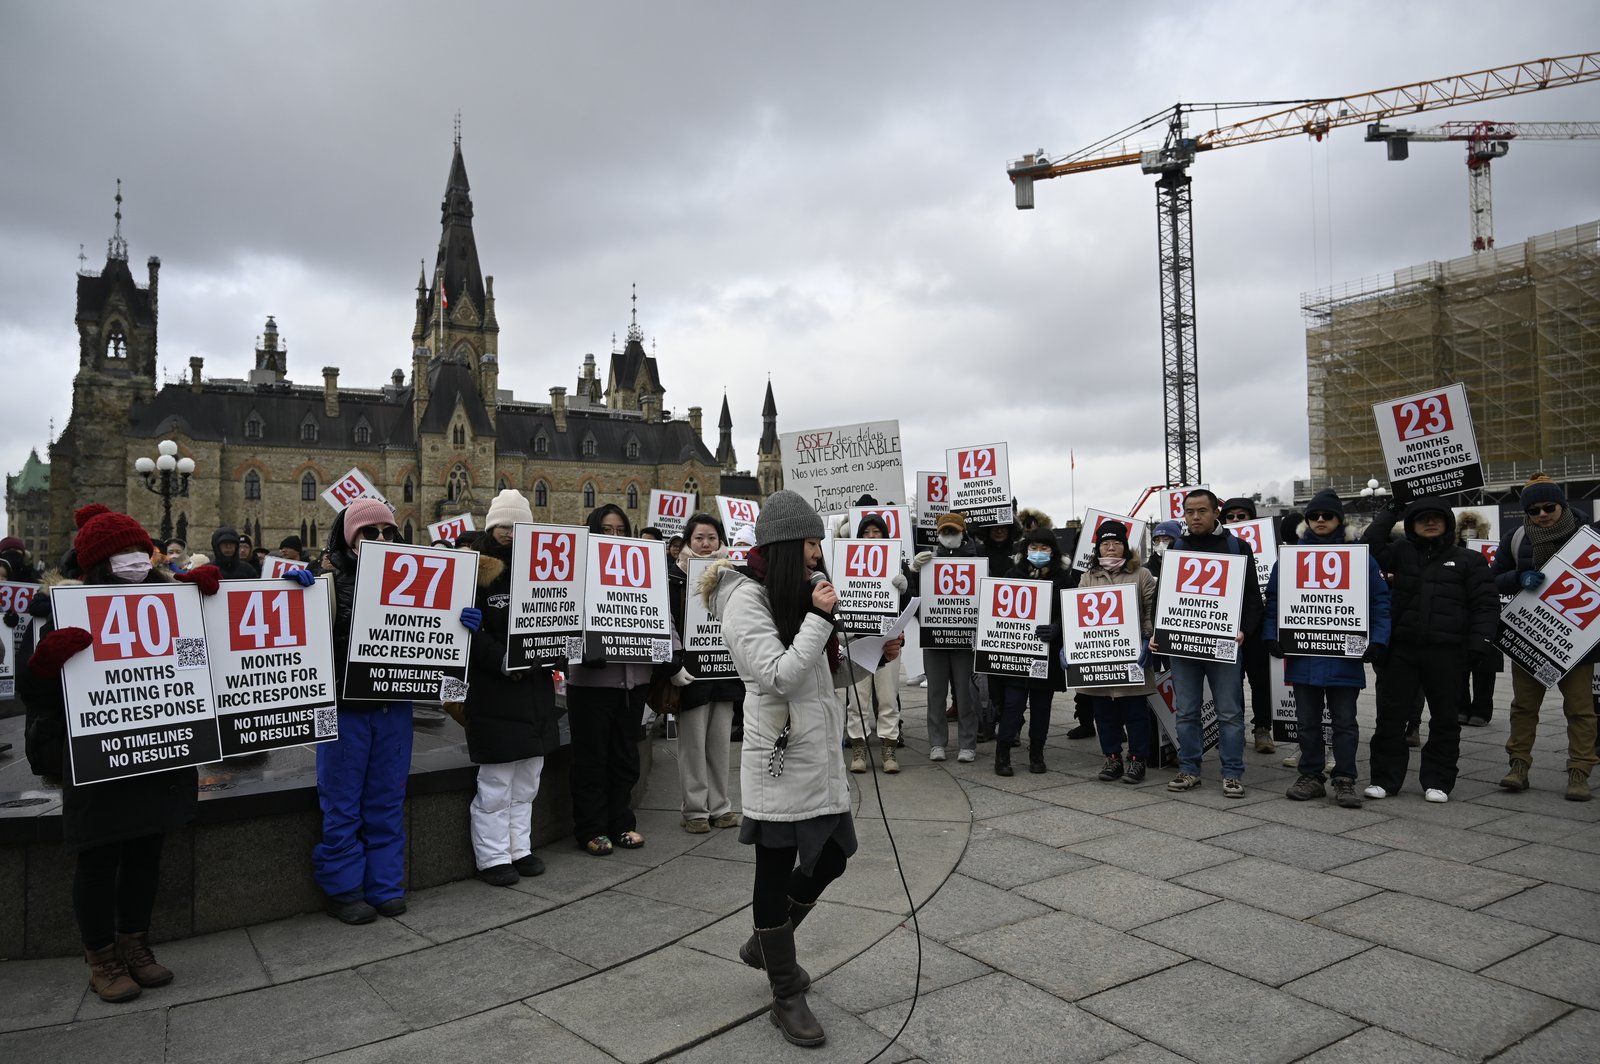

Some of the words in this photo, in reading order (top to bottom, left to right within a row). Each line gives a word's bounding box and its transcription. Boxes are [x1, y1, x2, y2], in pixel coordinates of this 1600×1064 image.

[1400, 398, 1446, 439] 23
[796, 432, 833, 450] ASSEZ
[836, 431, 852, 446] des
[857, 427, 883, 441] délais
[1406, 436, 1449, 453] MONTHS
[798, 437, 901, 464] INTERMINABLE
[1397, 449, 1440, 465] WAITING
[1443, 444, 1463, 455] FOR
[792, 469, 808, 479] Nos
[810, 468, 827, 476] vies
[831, 463, 849, 475] sont
[852, 463, 863, 472] en
[867, 458, 901, 471] suspens.
[963, 449, 992, 477] 42
[1394, 466, 1416, 477] IRCC
[1418, 453, 1472, 472] RESPONSE
[964, 480, 993, 488] MONTHS
[1407, 480, 1419, 488] NO
[1421, 470, 1464, 485] TIMELINES
[336, 479, 360, 503] 19
[814, 482, 877, 497] Transparence.
[957, 489, 986, 497] WAITING
[1413, 488, 1424, 496] NO
[1427, 480, 1462, 493] RESULTS
[663, 496, 683, 516] 70
[815, 498, 842, 512] Délais
[970, 495, 1006, 504] RESPONSE
[731, 502, 752, 521] 29
[441, 522, 462, 544] 27
[535, 534, 570, 580] 53
[850, 545, 883, 576] 40
[605, 545, 645, 586] 40
[1304, 552, 1342, 588] 19
[388, 554, 447, 607] 27
[939, 565, 970, 595] 65
[1181, 559, 1222, 595] 22
[849, 581, 881, 589] MONTHS
[532, 588, 567, 598] MONTHS
[607, 592, 647, 603] MONTHS
[841, 590, 872, 598] WAITING
[874, 591, 889, 599] FOR
[1301, 595, 1343, 603] MONTHS
[522, 602, 557, 613] WAITING
[560, 602, 575, 612] FOR
[998, 586, 1032, 618] 90
[1082, 592, 1119, 625] 32
[1179, 597, 1219, 609] MONTHS
[1545, 577, 1600, 626] 22
[597, 604, 637, 615] WAITING
[640, 606, 658, 616] FOR
[1168, 607, 1207, 618] WAITING
[1210, 612, 1228, 621] FOR
[1290, 605, 1331, 614] WAITING
[1335, 606, 1354, 615] FOR
[101, 595, 170, 657] 40
[239, 591, 297, 647] 41
[385, 614, 441, 628] MONTHS
[516, 617, 535, 628] IRCC
[536, 615, 579, 627] RESPONSE
[591, 616, 612, 626] IRCC
[615, 618, 664, 629] RESPONSE
[996, 621, 1030, 630] MONTHS
[1162, 617, 1181, 626] IRCC
[1183, 620, 1233, 632] RESPONSE
[1285, 616, 1305, 624] IRCC
[1308, 617, 1361, 626] RESPONSE
[1534, 605, 1572, 636] MONTHS
[369, 629, 424, 643] WAITING
[429, 632, 454, 644] FOR
[987, 631, 1020, 640] WAITING
[1023, 633, 1039, 641] FOR
[1084, 629, 1119, 639] MONTHS
[1503, 629, 1514, 640] NO
[1518, 607, 1555, 640] WAITING
[1554, 635, 1574, 652] FOR
[523, 638, 534, 647] NO
[602, 636, 613, 644] NO
[690, 637, 710, 646] IRCC
[1075, 640, 1111, 649] WAITING
[1113, 639, 1130, 647] FOR
[1500, 638, 1511, 648] NO
[1505, 612, 1526, 629] IRCC
[1524, 627, 1571, 663] RESPONSE
[358, 644, 388, 657] IRCC
[390, 647, 460, 660] RESPONSE
[606, 647, 617, 655] NO
[620, 647, 652, 656] RESULTS
[981, 640, 999, 648] IRCC
[1000, 641, 1043, 651] RESPONSE
[1184, 644, 1216, 654] RESULTS
[1311, 642, 1346, 650] RESULTS
[241, 652, 301, 670] MONTHS
[525, 650, 535, 659] NO
[537, 649, 566, 657] RESULTS
[1071, 652, 1089, 660] IRCC
[1091, 649, 1136, 658] RESPONSE
[105, 665, 175, 684] MONTHS
[370, 668, 385, 678] NO
[388, 669, 444, 680] TIMELINES
[701, 664, 711, 672] NO
[1002, 664, 1030, 672] RESULTS
[1091, 664, 1128, 672] TIMELINES
[226, 671, 286, 689] WAITING
[291, 668, 317, 682] FOR
[89, 685, 159, 706] WAITING
[165, 682, 195, 698] FOR
[373, 681, 388, 691] NO
[392, 682, 438, 693] RESULTS
[218, 692, 250, 708] IRCC
[253, 684, 326, 703] RESPONSE
[80, 710, 118, 727] IRCC
[122, 699, 206, 722] RESPONSE
[234, 718, 251, 730] NO
[253, 709, 313, 727] TIMELINES
[1277, 709, 1293, 717] IRCC
[102, 738, 121, 752] NO
[124, 728, 193, 748] TIMELINES
[240, 731, 257, 744] NO
[260, 724, 309, 741] RESULTS
[110, 754, 128, 768] NO
[133, 744, 189, 764] RESULTS
